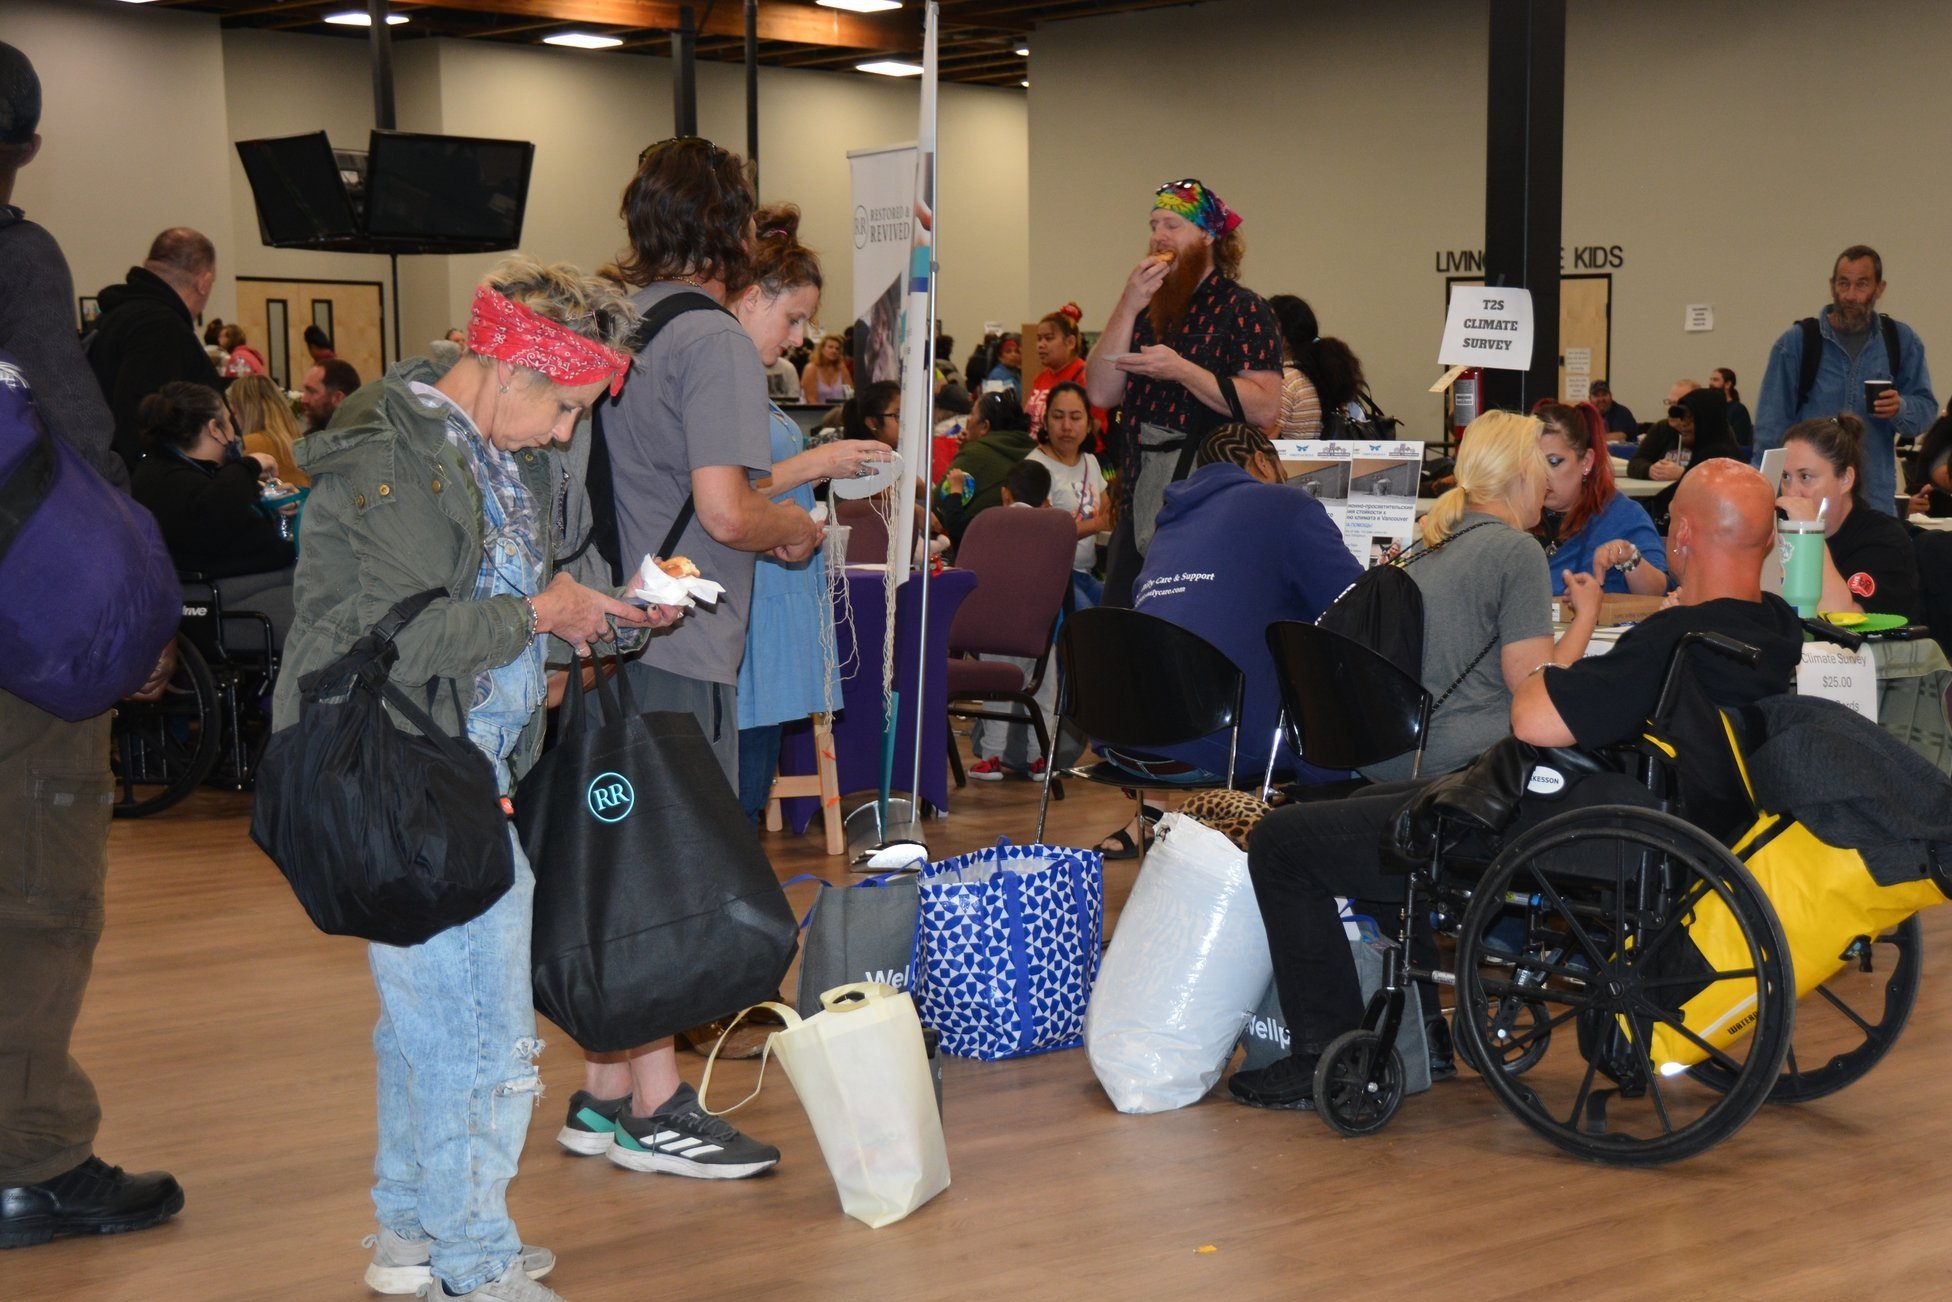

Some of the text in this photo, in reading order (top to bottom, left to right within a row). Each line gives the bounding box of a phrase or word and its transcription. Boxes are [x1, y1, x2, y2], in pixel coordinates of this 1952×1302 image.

[870, 206, 904, 221] RESTORED
[870, 222, 910, 243] REVIVED
[1436, 251, 1485, 272] LIVIN
[1574, 245, 1624, 269] KIDS
[1482, 299, 1505, 311] T2S
[1463, 318, 1519, 332] CLIMATE
[1462, 337, 1513, 351] SURVEY
[1155, 576, 1173, 585] Care
[1173, 573, 1180, 582] &
[1180, 572, 1215, 582] Support
[1801, 652, 1867, 667] Climate Survey
[1822, 675, 1853, 688] $25.00
[1531, 775, 1560, 785] KESSON
[593, 783, 630, 811] RR
